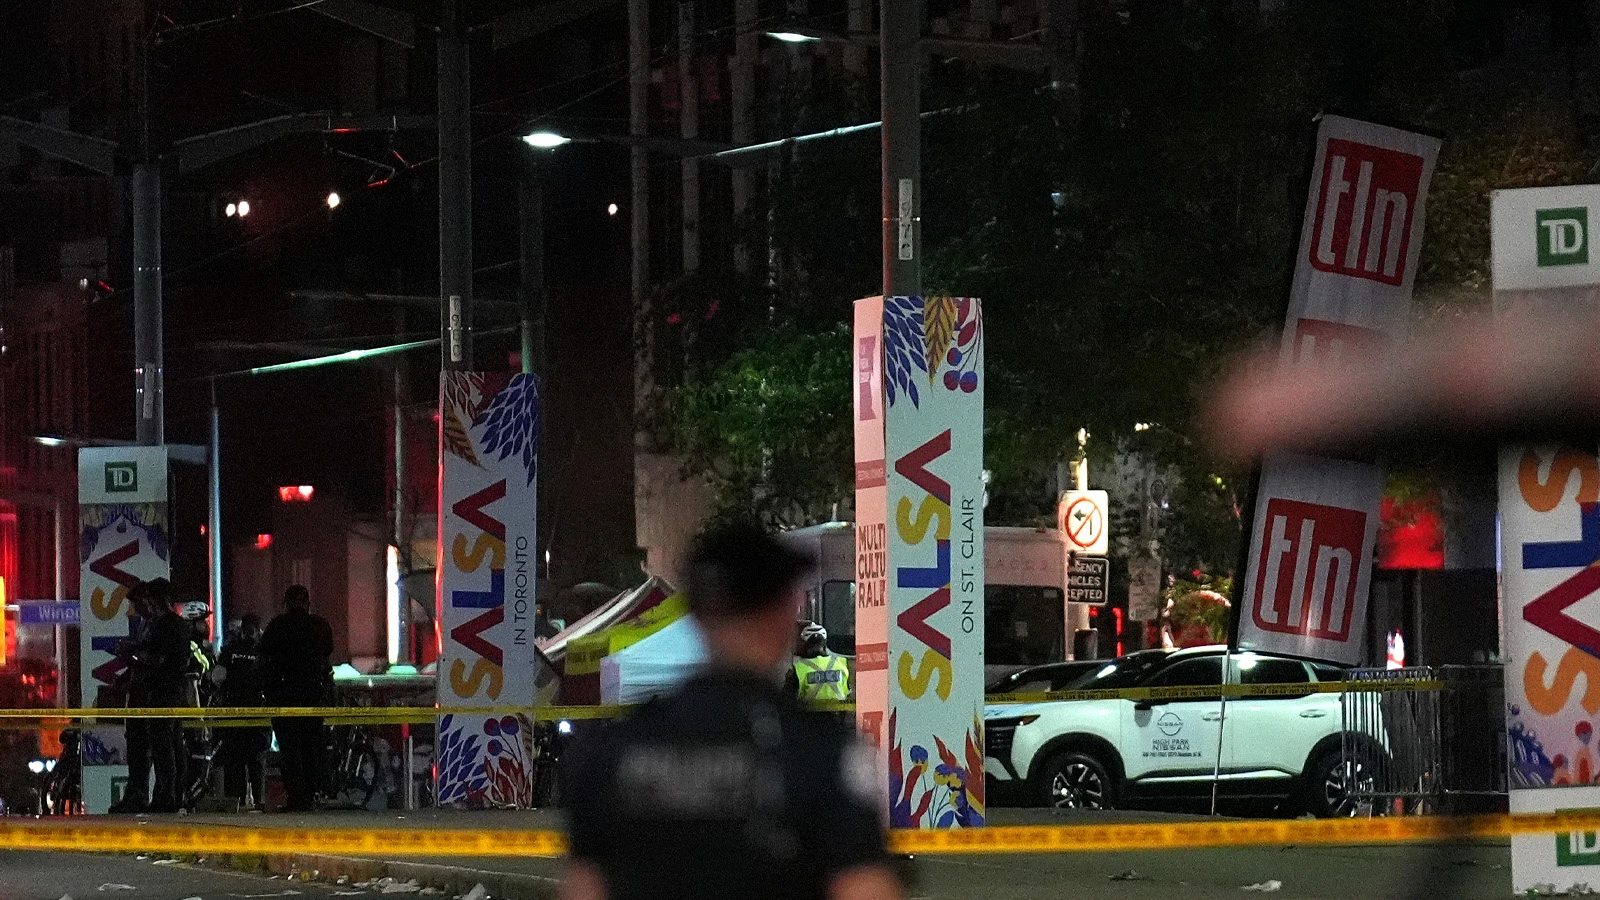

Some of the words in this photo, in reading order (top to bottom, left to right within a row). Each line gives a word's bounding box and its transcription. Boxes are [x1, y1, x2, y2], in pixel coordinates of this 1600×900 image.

[1316, 156, 1408, 278] tln
[1541, 218, 1584, 255] TD
[107, 467, 134, 487] TD
[858, 523, 886, 552] MULTI
[961, 497, 974, 559] CLAIR
[514, 536, 527, 626] TORONTO
[858, 551, 886, 580] CULTU
[895, 428, 953, 702] SALSA
[961, 566, 974, 594] ST.
[1068, 576, 1102, 587] HICLES
[1070, 562, 1103, 573] GENCY
[1259, 515, 1353, 633] tln
[450, 478, 507, 701] SALSA
[961, 600, 974, 634] ON
[513, 627, 526, 645] IN
